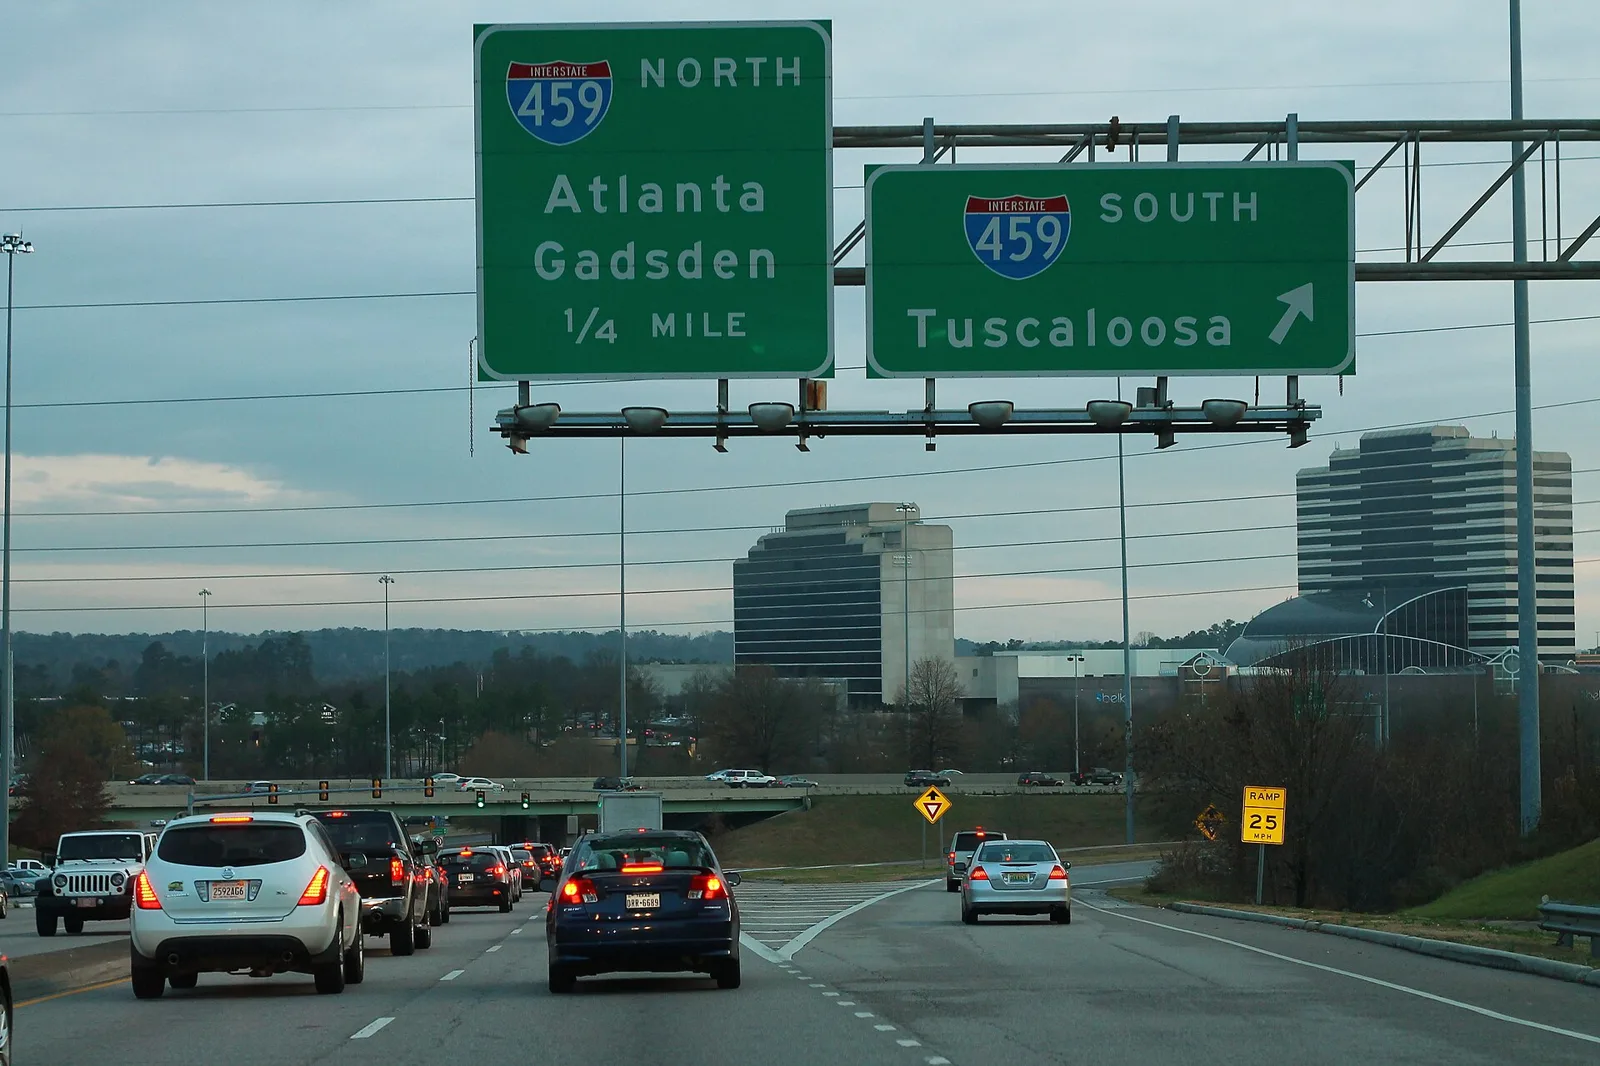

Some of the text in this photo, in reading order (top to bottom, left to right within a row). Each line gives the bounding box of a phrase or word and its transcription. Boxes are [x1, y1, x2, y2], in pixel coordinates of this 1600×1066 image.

[530, 66, 588, 77] INTERSTATE
[641, 56, 801, 88] NORTH
[517, 80, 603, 127] 459
[544, 174, 765, 214] Atlanta
[988, 200, 1046, 212] INTERSTATE
[1099, 192, 1258, 223] SOUTH
[975, 215, 1062, 262] 459
[534, 240, 776, 281] Gadsden
[563, 307, 746, 344] 1/4 MILE
[907, 307, 1231, 348] Tuscaloosa
[1102, 692, 1126, 703] belk
[1250, 792, 1280, 801] RAMP
[1249, 814, 1277, 830] 25
